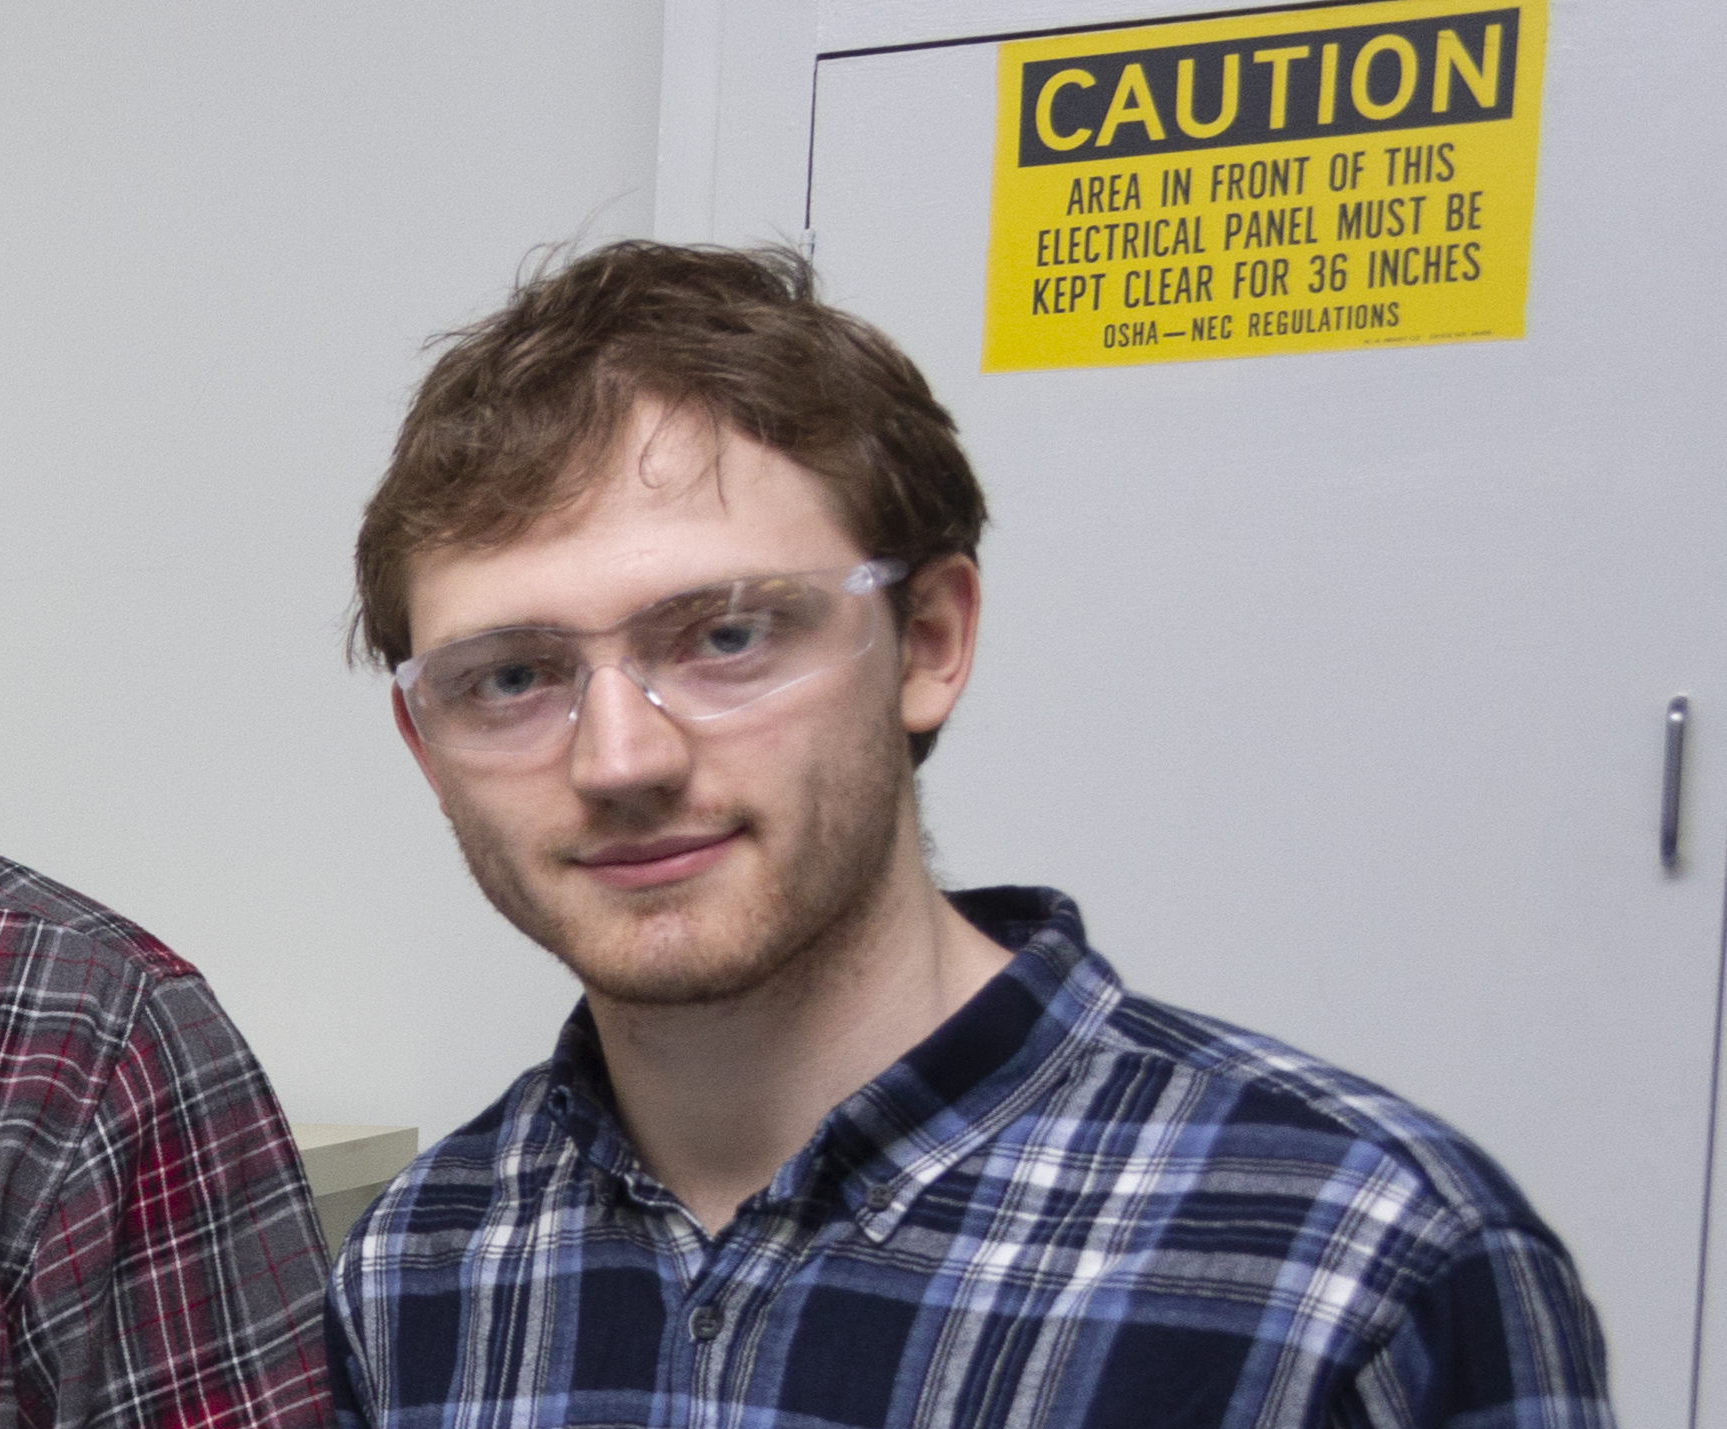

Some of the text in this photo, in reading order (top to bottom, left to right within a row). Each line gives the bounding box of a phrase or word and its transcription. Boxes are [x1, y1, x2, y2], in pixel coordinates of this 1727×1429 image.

[1036, 25, 1501, 150] CAUTION
[1067, 143, 1454, 215] AREA IN FRONT OF THIS
[1037, 191, 1482, 266] ELECTRICAL PANEL MUST BE
[1033, 242, 1480, 315] KEPT CLEAR FOR 36 INCHES
[1249, 302, 1398, 337] REGULATIONS
